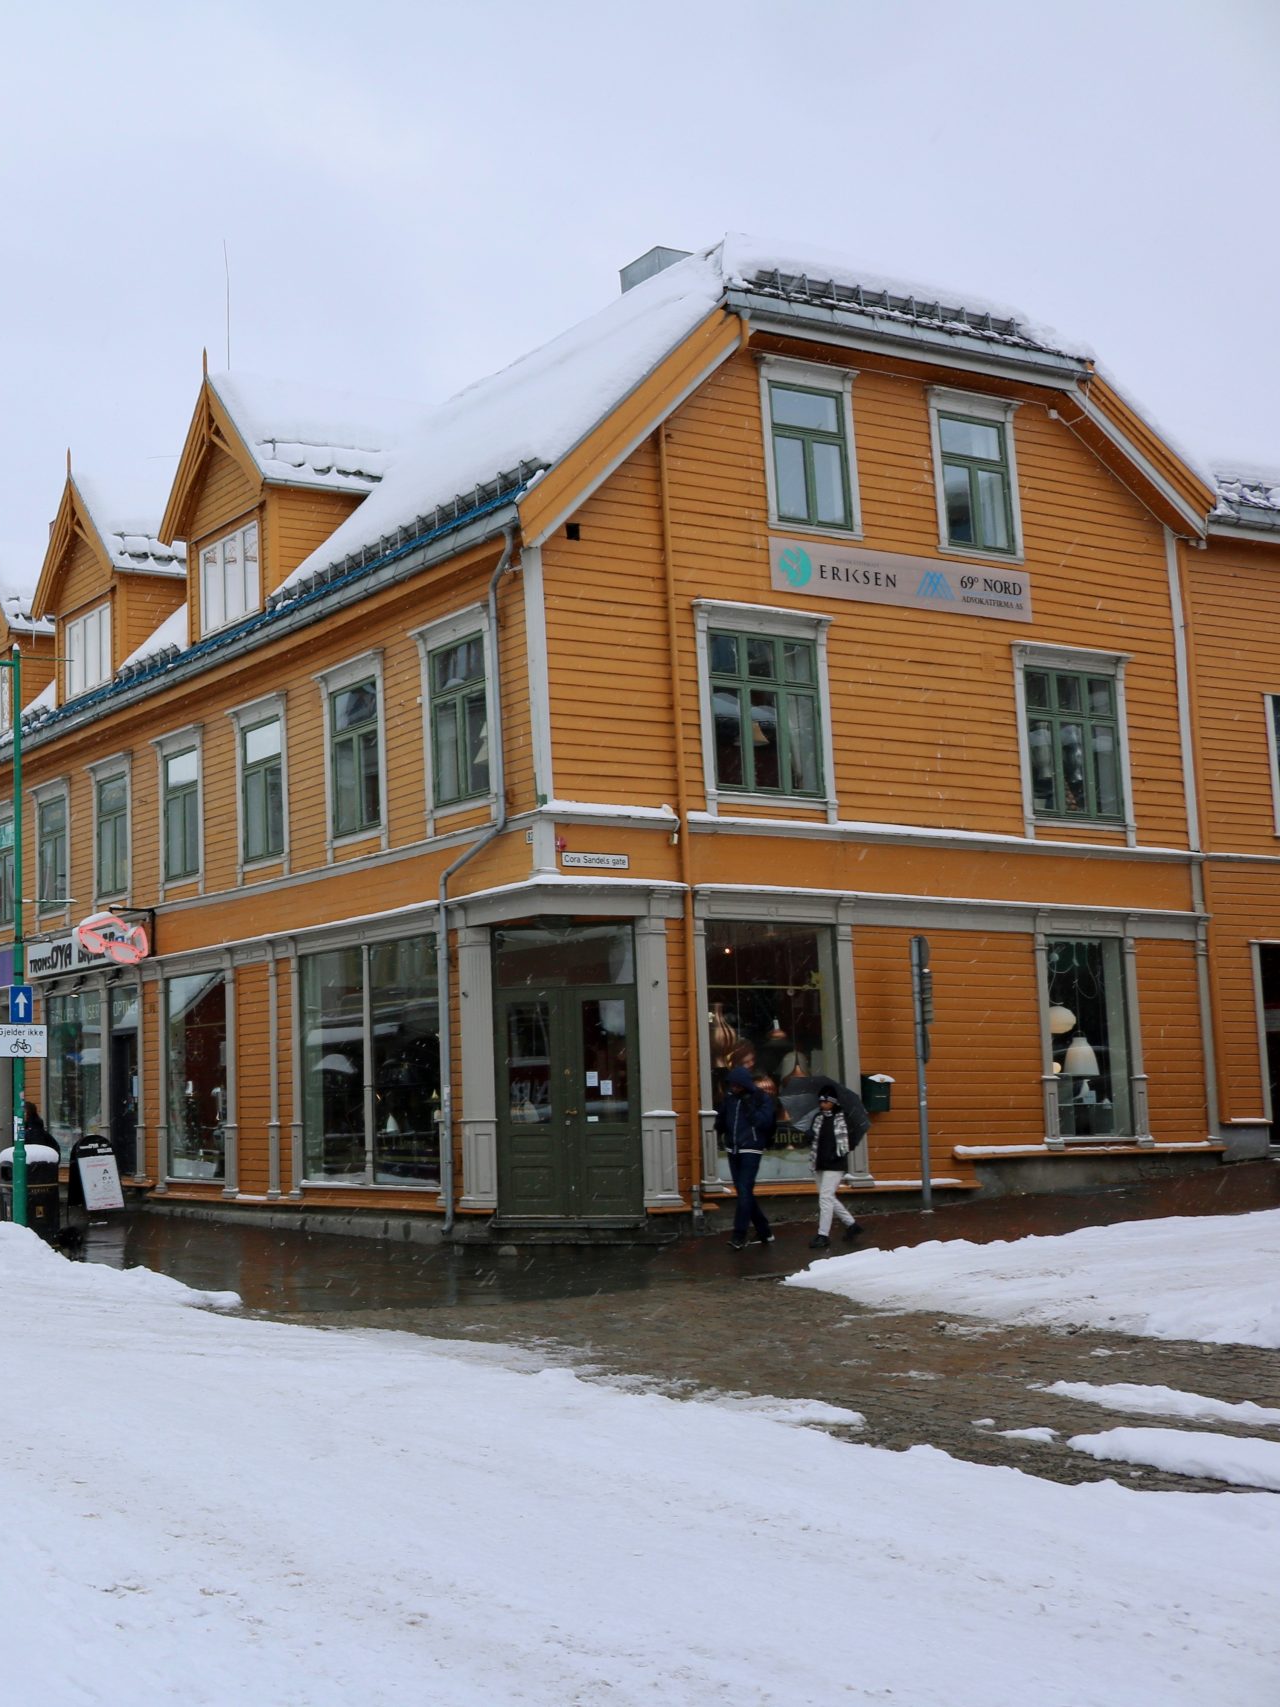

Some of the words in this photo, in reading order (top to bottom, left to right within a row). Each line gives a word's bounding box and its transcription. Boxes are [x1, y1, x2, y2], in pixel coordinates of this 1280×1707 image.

[819, 564, 897, 588] ERIKSEN
[983, 578, 1022, 596] NORD
[961, 596, 1014, 609] ADVOKATFIRMA
[564, 854, 581, 864] Cora
[583, 855, 610, 865] Sandels
[611, 858, 627, 867] gate
[27, 1027, 44, 1037] ikke
